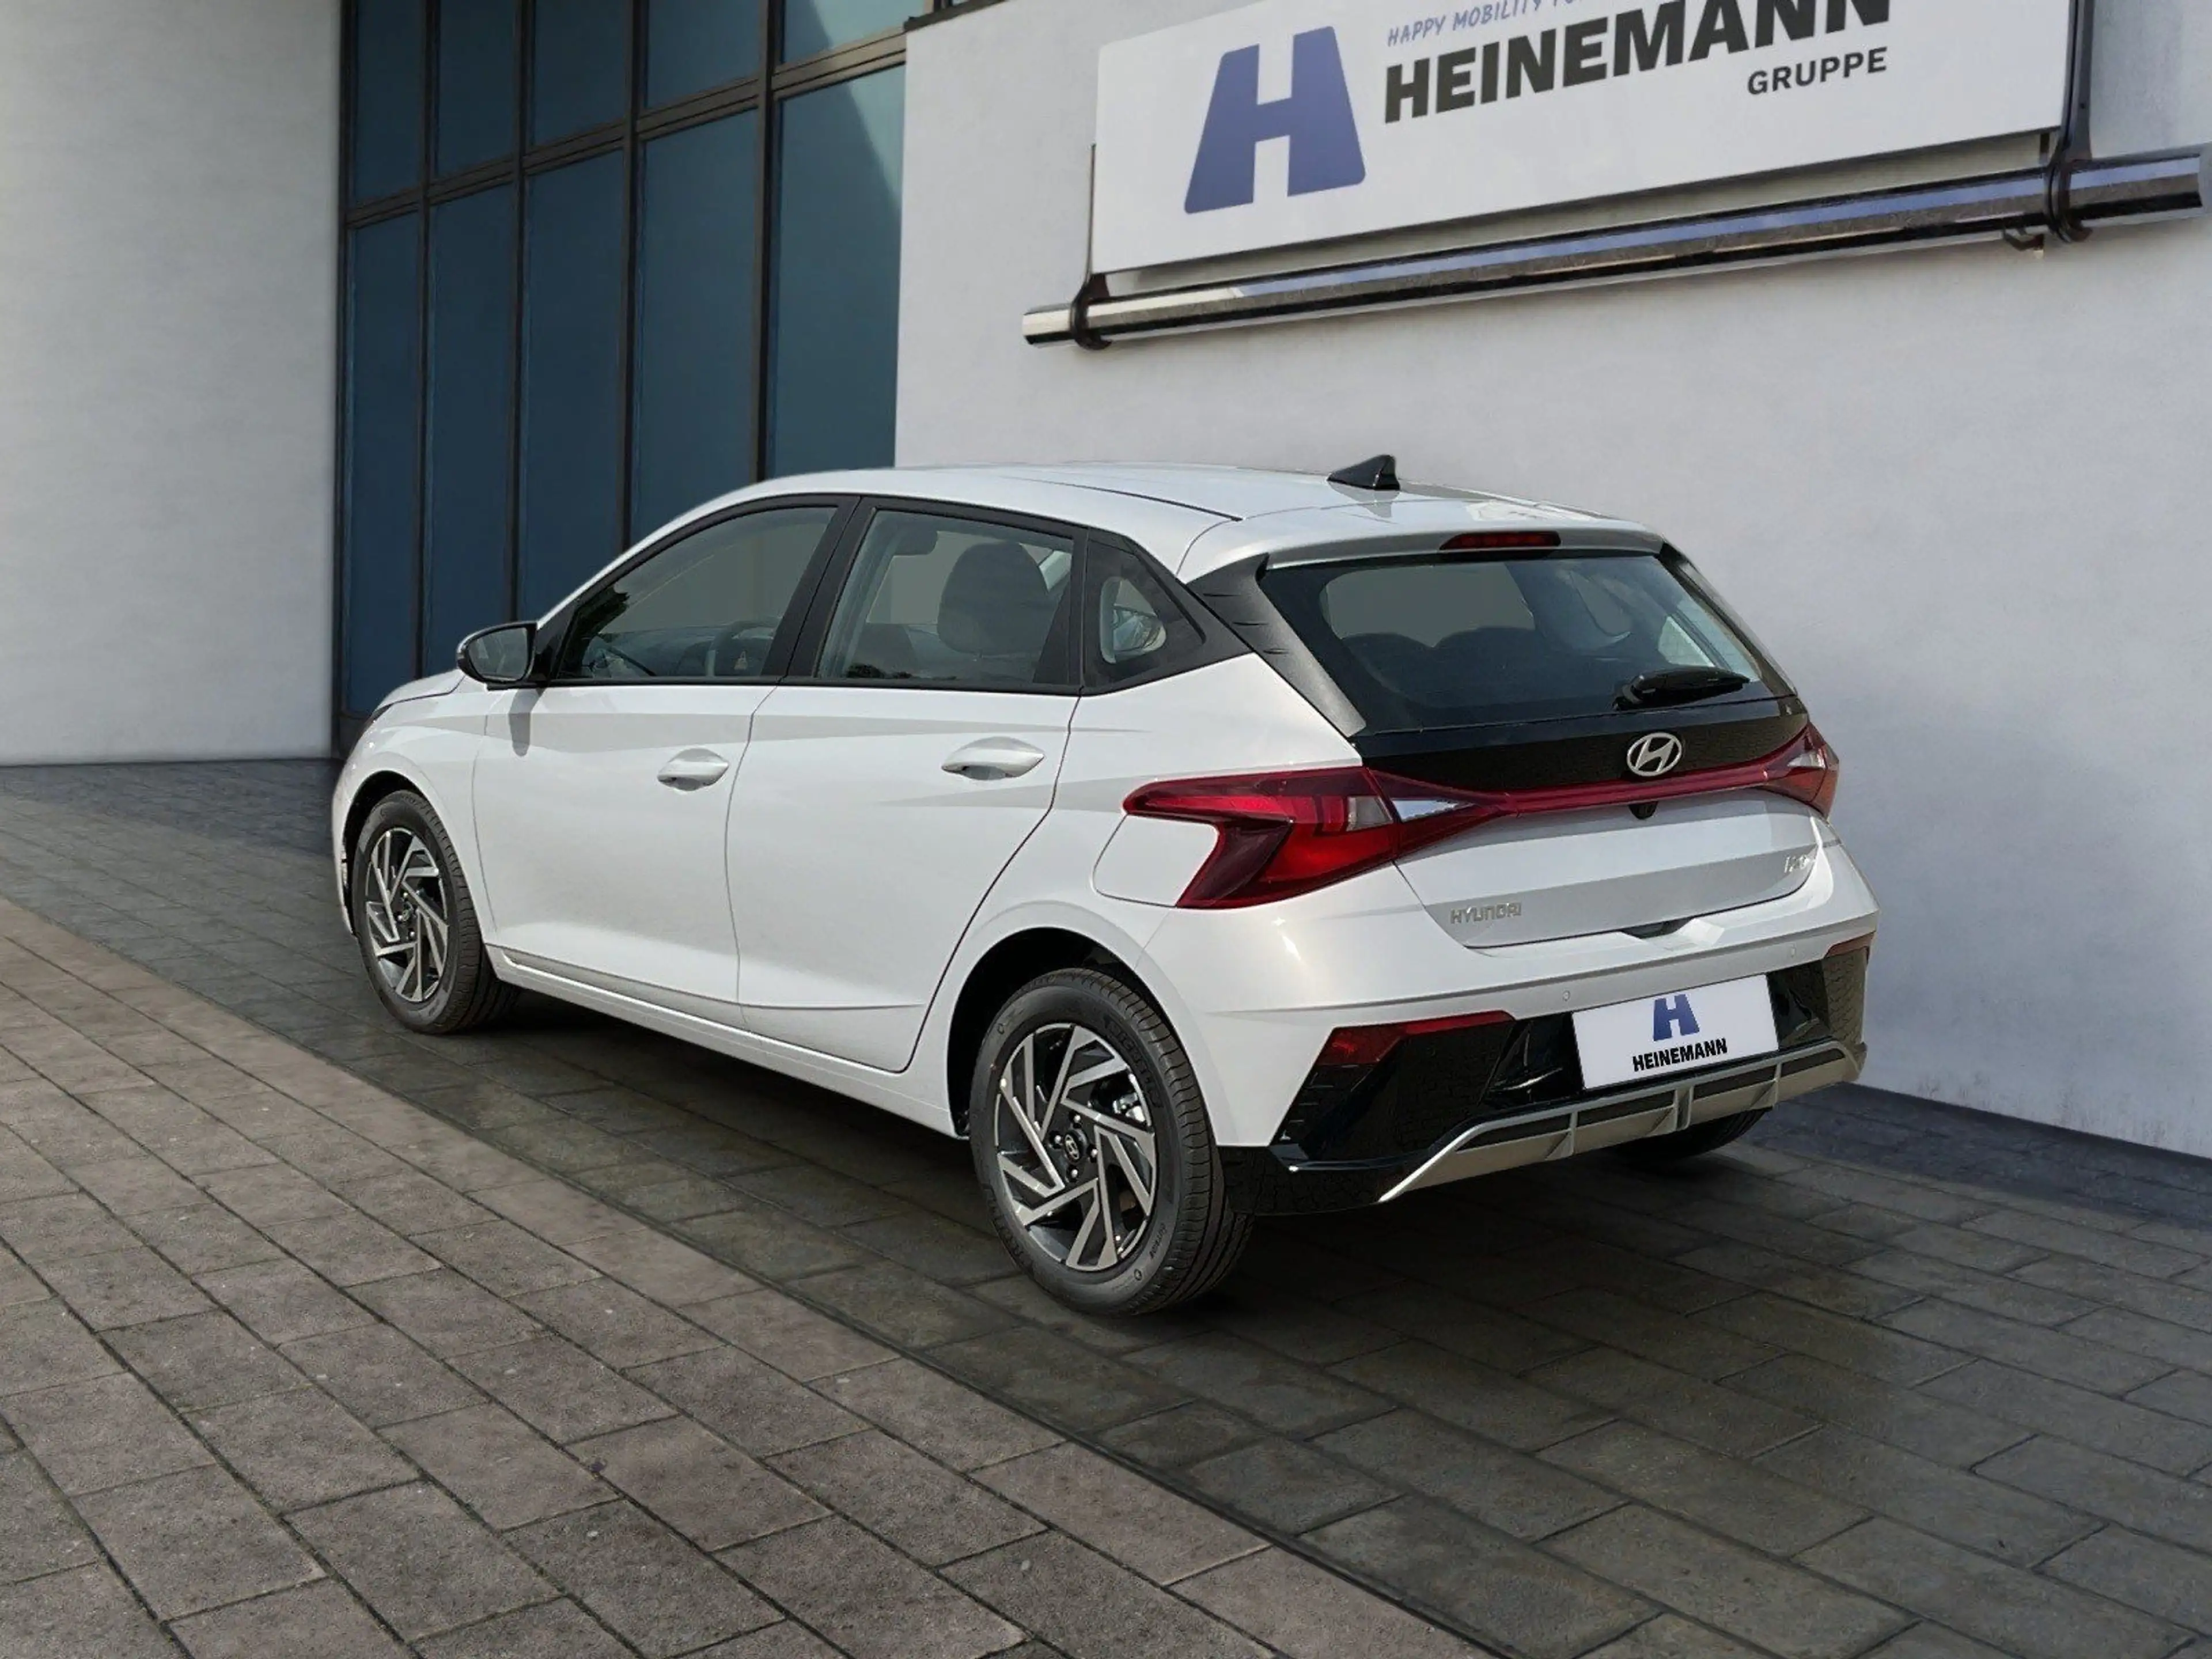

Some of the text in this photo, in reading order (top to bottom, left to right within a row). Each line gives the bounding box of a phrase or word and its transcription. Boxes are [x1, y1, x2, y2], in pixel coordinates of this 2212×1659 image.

[1388, 16, 1445, 47] HAPPY
[1747, 47, 1887, 95] GRUPPE
[1184, 26, 1366, 214] H
[1450, 902, 1522, 923] HYUNDAI
[1653, 994, 1700, 1041] H
[1633, 1038, 1728, 1071] HEINEMANN
